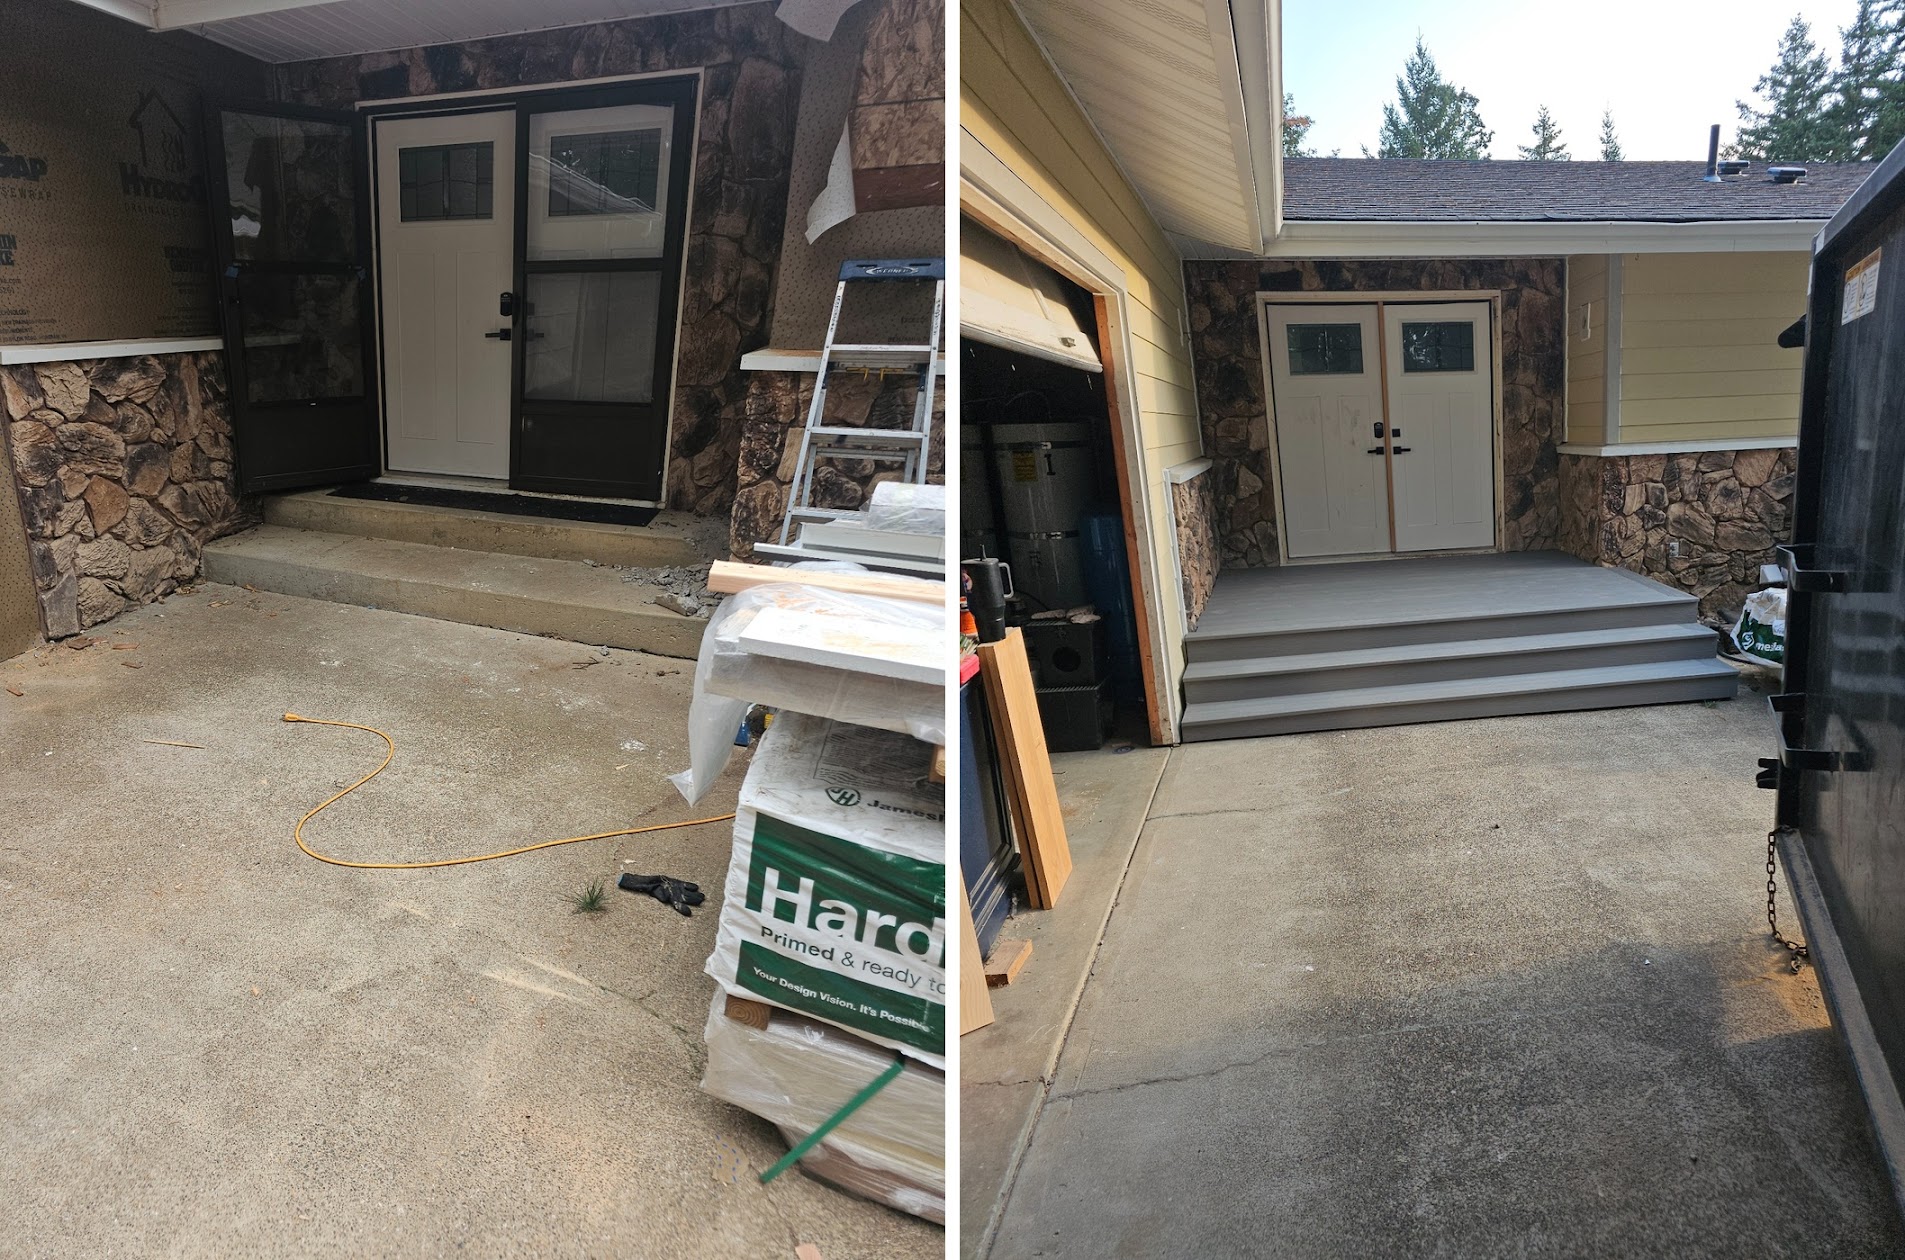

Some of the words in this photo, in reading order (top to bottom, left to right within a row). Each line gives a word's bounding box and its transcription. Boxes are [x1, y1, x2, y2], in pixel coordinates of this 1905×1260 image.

[760, 866, 944, 968] Hard
[761, 925, 836, 962] Primed
[840, 951, 856, 969] &
[861, 959, 922, 989] ready
[753, 966, 778, 983] Your
[778, 977, 818, 1000] Design
[819, 991, 857, 1012] Vision.
[859, 1004, 878, 1018] It's
